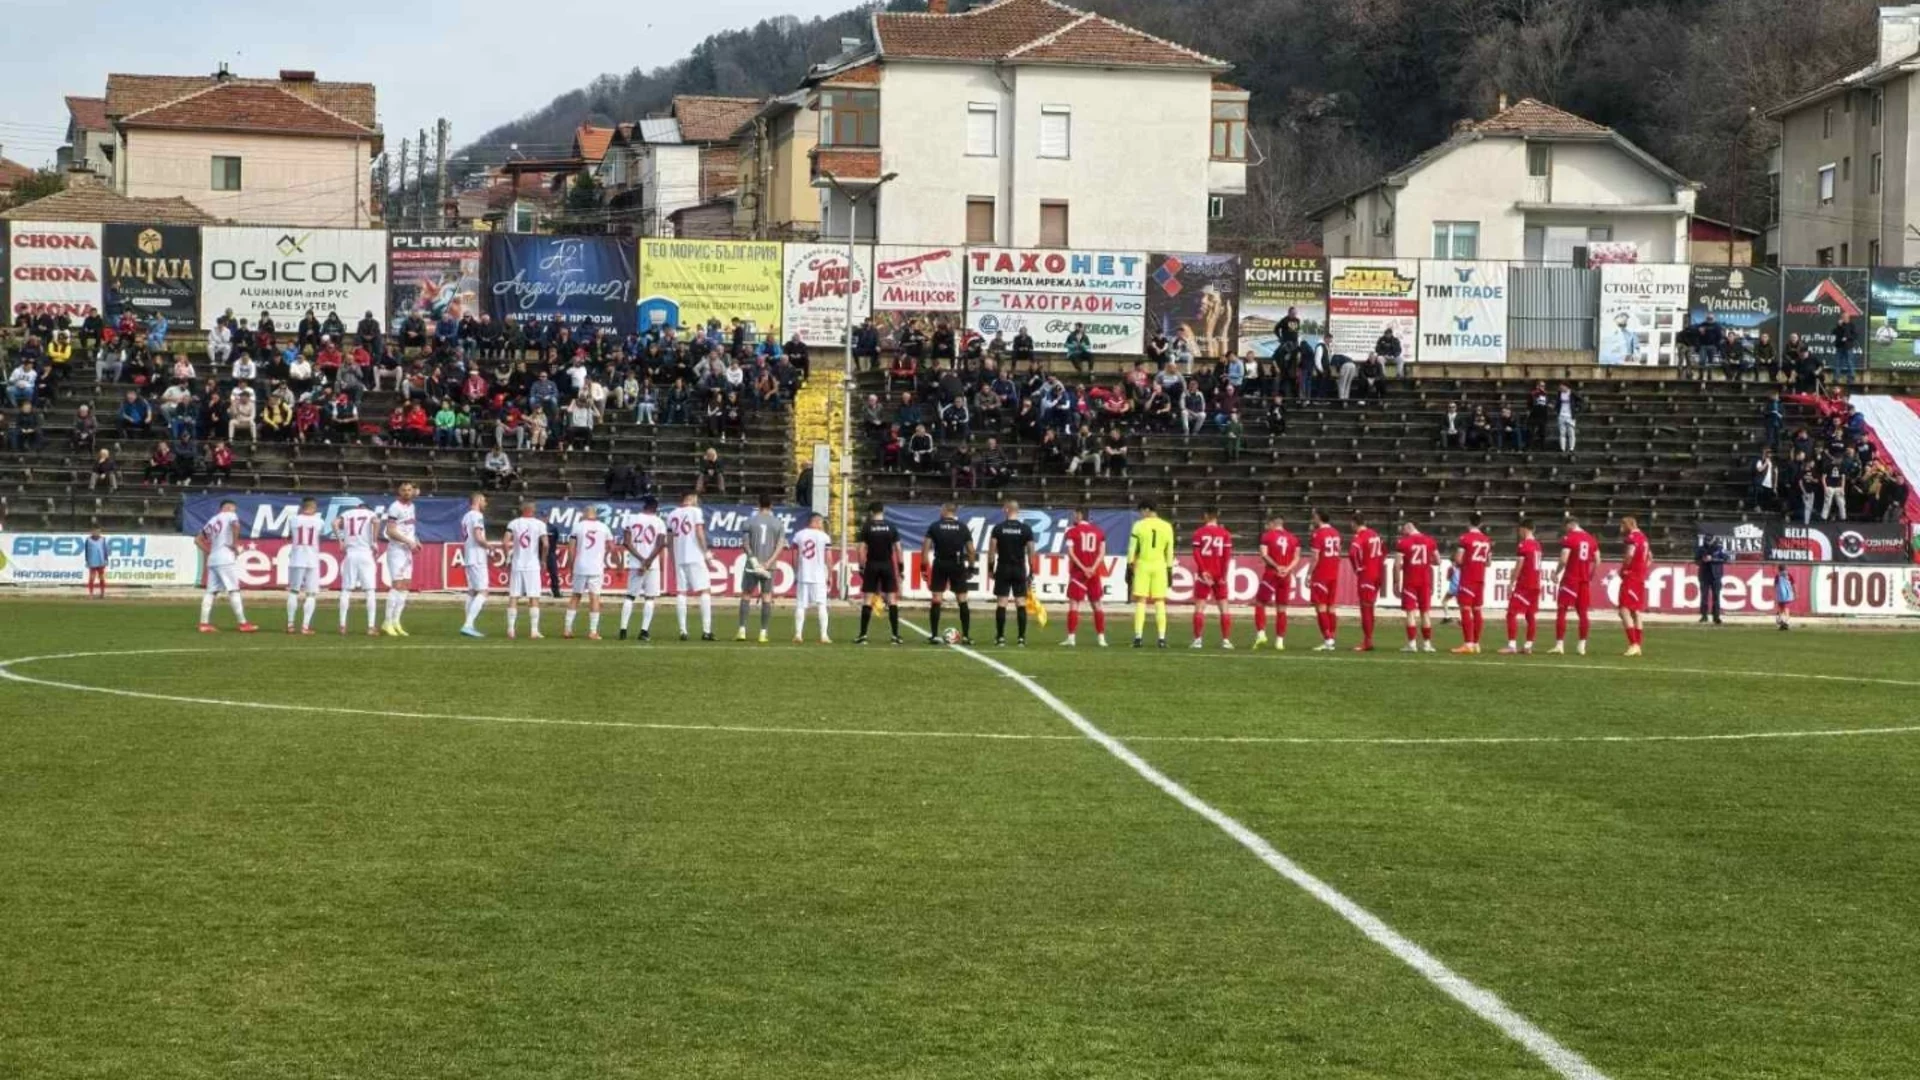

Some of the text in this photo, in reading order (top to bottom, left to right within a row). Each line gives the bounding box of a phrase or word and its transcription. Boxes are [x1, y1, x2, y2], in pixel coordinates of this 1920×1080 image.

[14, 234, 97, 249] CHONA
[393, 236, 480, 248] PLAMEN
[646, 243, 777, 261] ТЕО МОРИС-БЪЛГАРИЯ
[109, 257, 193, 284] VALTATA
[211, 260, 377, 284] OGICOM
[971, 252, 1140, 276] ТАХОНЕТ
[1253, 258, 1317, 268] COMPLEX
[14, 267, 97, 282] CHONA
[973, 276, 1032, 286] СЕРВИЗНАТА
[1035, 278, 1072, 287] МРЕЖА
[1074, 278, 1086, 288] ЗА
[1088, 280, 1135, 289] SMART
[1245, 269, 1325, 283] KOMITITE
[240, 287, 349, 298] ALUMINIUM and PVC
[1425, 285, 1503, 299] TIMTRADE
[1604, 283, 1686, 294] СТОНАС ГРУП
[251, 301, 337, 310] FACADE SYSTEM
[1001, 293, 1113, 312] ТАХОГРАФИ
[1115, 302, 1143, 310] VDO
[1424, 333, 1502, 348] TIMTRADE
[298, 525, 316, 547] 11
[348, 516, 368, 537] 17
[631, 522, 656, 545] 20
[670, 516, 693, 538] 26
[759, 523, 768, 546] 1
[519, 529, 532, 550] 6
[585, 530, 597, 550] 5
[1081, 532, 1096, 552] 10
[1151, 528, 1157, 549] 1
[803, 539, 817, 560] 8
[1411, 544, 1428, 565] 21
[1471, 540, 1490, 563] 23
[1580, 541, 1590, 561] 8
[1826, 570, 1888, 608] 100
